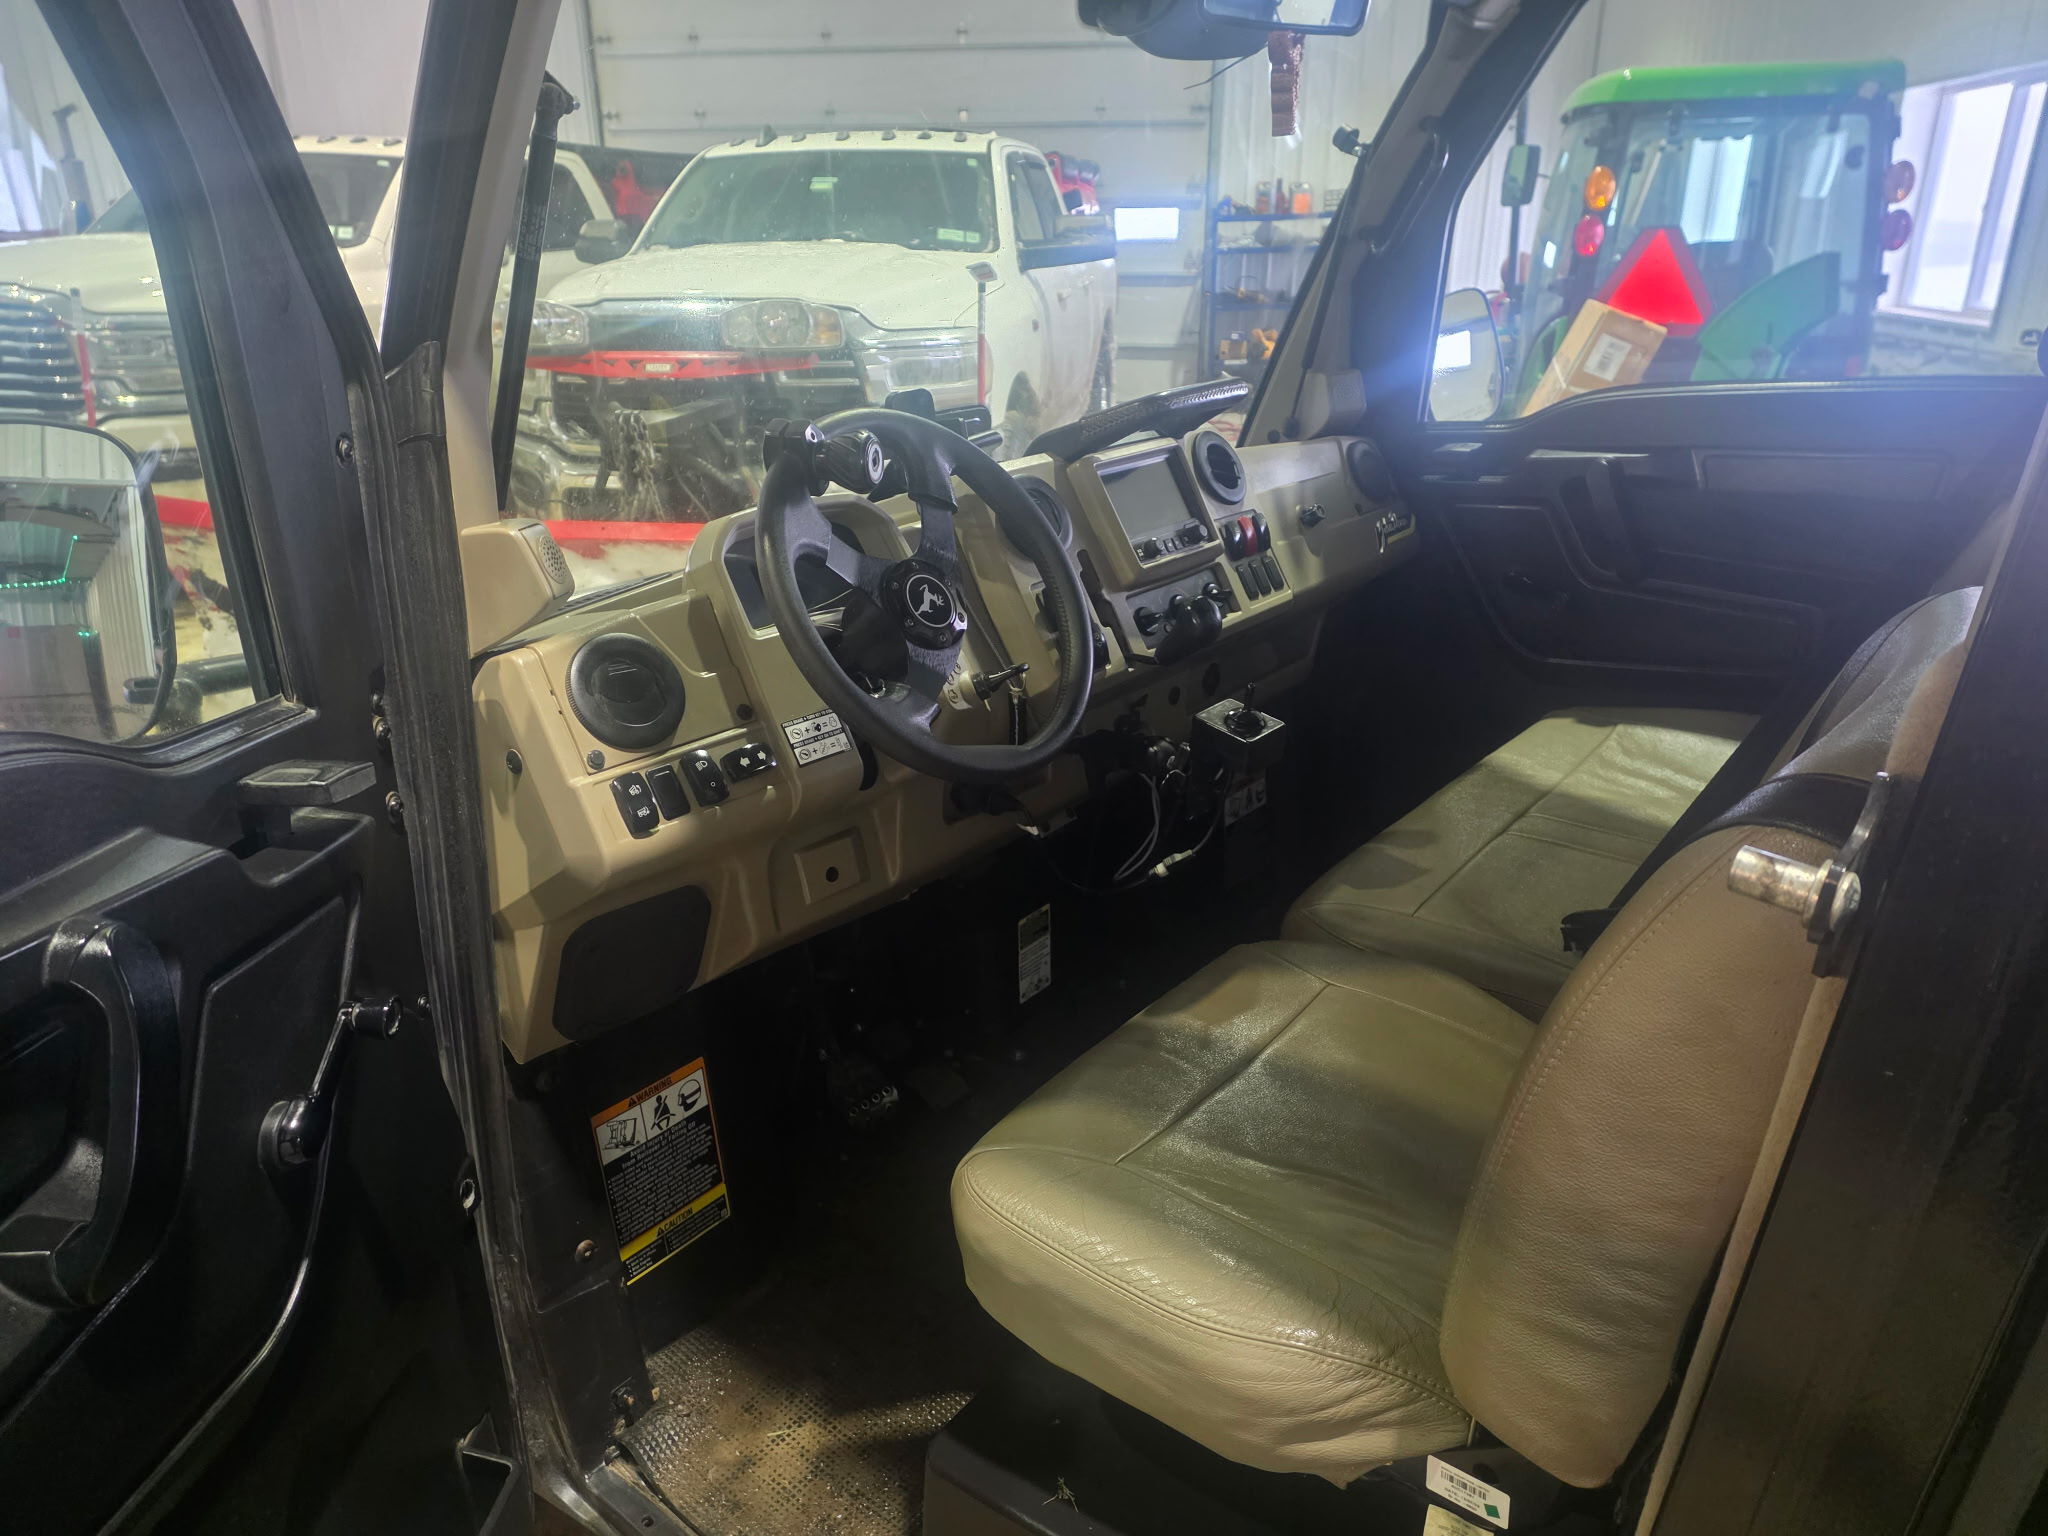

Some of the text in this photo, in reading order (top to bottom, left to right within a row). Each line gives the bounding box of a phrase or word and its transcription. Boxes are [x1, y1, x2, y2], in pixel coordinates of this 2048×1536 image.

[636, 1076, 672, 1102] WARNING
[622, 1156, 636, 1169] from
[637, 1142, 660, 1161] Rollover
[630, 1144, 646, 1158] Avoid
[647, 1134, 663, 1148] Injury
[663, 1207, 693, 1232] CAUTION
